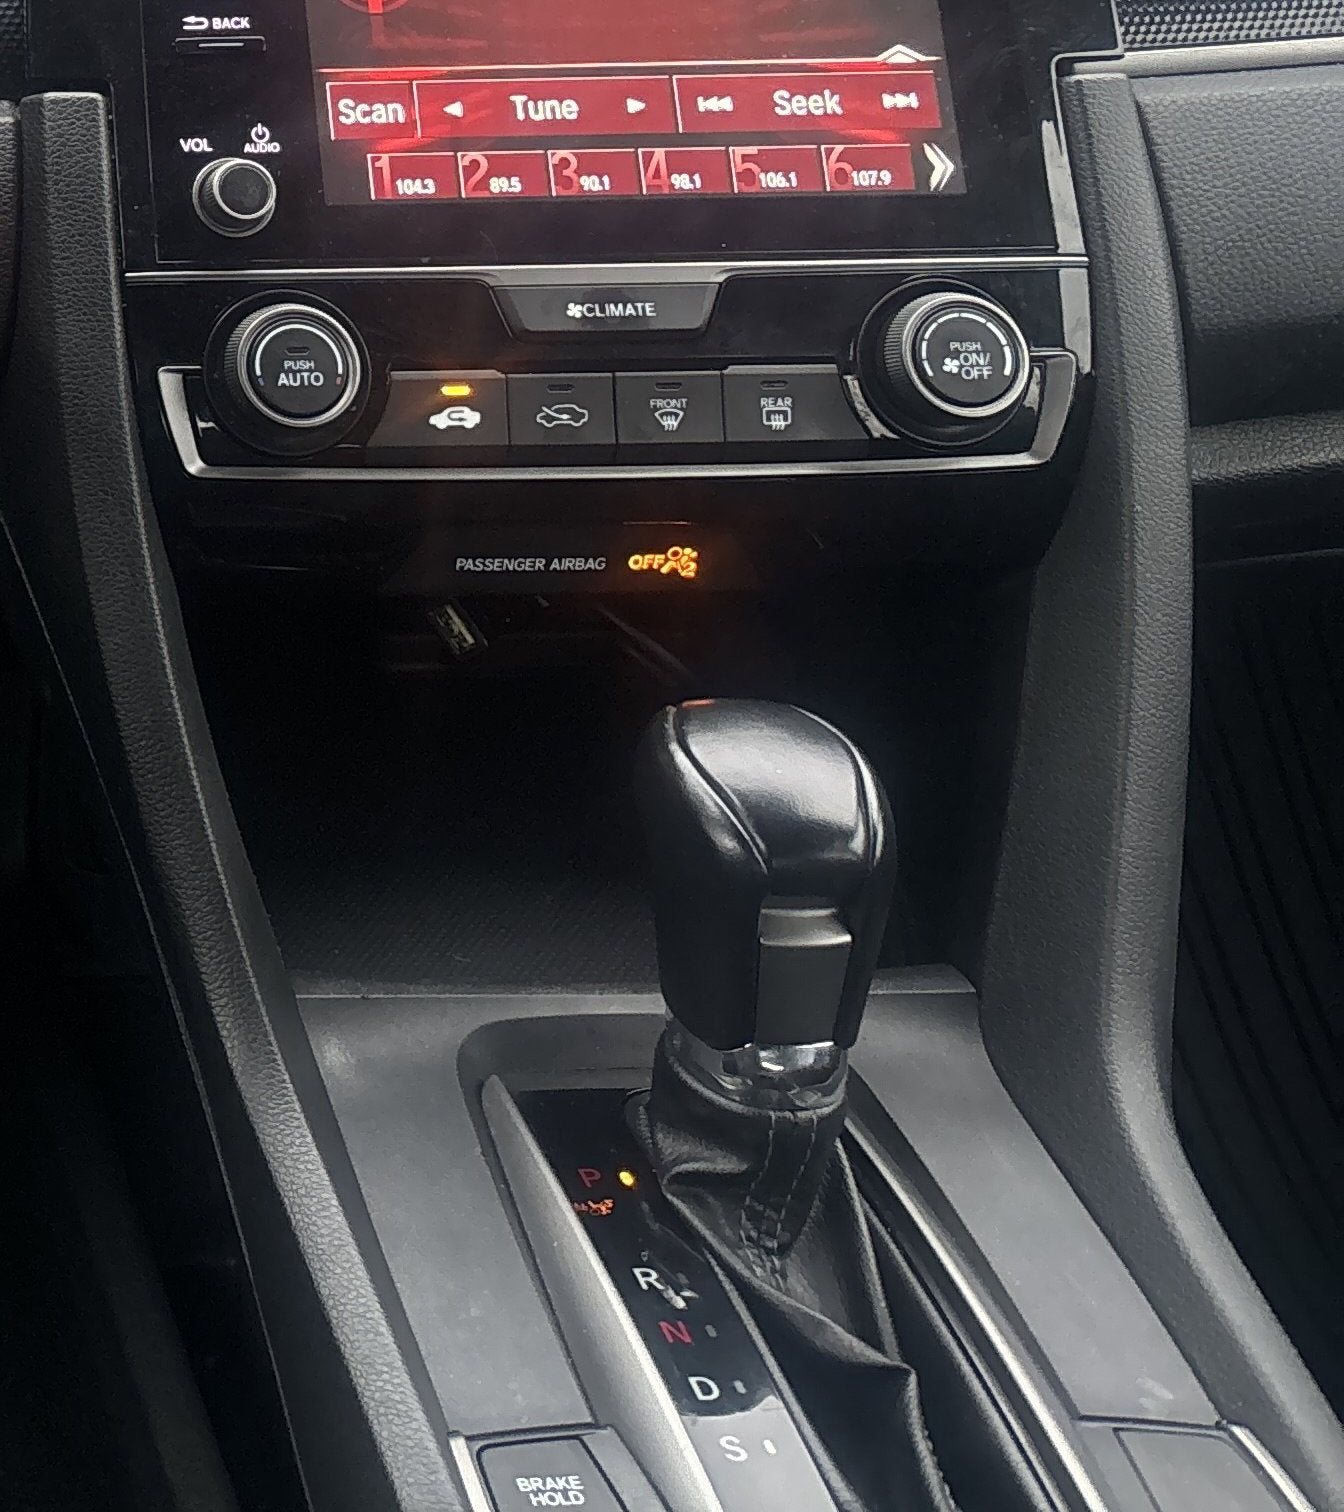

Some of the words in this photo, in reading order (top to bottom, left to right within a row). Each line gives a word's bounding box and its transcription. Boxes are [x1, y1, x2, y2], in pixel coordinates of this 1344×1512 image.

[211, 16, 250, 30] BACK
[337, 98, 406, 125] Scan
[510, 94, 579, 121] Tune
[771, 89, 844, 116] Seek
[179, 138, 213, 153] VOL
[244, 142, 281, 154] AUDIO
[374, 155, 392, 198] 1
[462, 154, 489, 196] 2
[489, 176, 522, 193] 89.5
[552, 152, 579, 196] 3
[579, 174, 610, 191] 90.1
[645, 149, 670, 194] 4
[670, 173, 702, 190] 98.1
[734, 149, 761, 191] 5
[759, 172, 798, 188] 106.1
[827, 147, 853, 190] 6
[851, 170, 892, 187] 107.9
[582, 302, 657, 318] CLIMATE
[950, 342, 982, 352] PUSH
[283, 359, 315, 370] PUSH
[960, 352, 991, 367] ON/
[277, 372, 324, 387] AUTO
[961, 366, 993, 381] OFF
[649, 398, 688, 409] FRONT
[760, 397, 793, 408] REAR
[455, 557, 545, 572] PASSENGER
[549, 557, 607, 571] AIRBAG
[628, 554, 665, 570] OFF
[577, 1168, 601, 1188] P
[632, 1267, 659, 1290] R
[659, 1320, 693, 1345] N
[688, 1376, 720, 1401] D
[719, 1435, 749, 1462] S
[515, 1475, 585, 1492] BRAKE
[528, 1490, 585, 1507] HOLD
